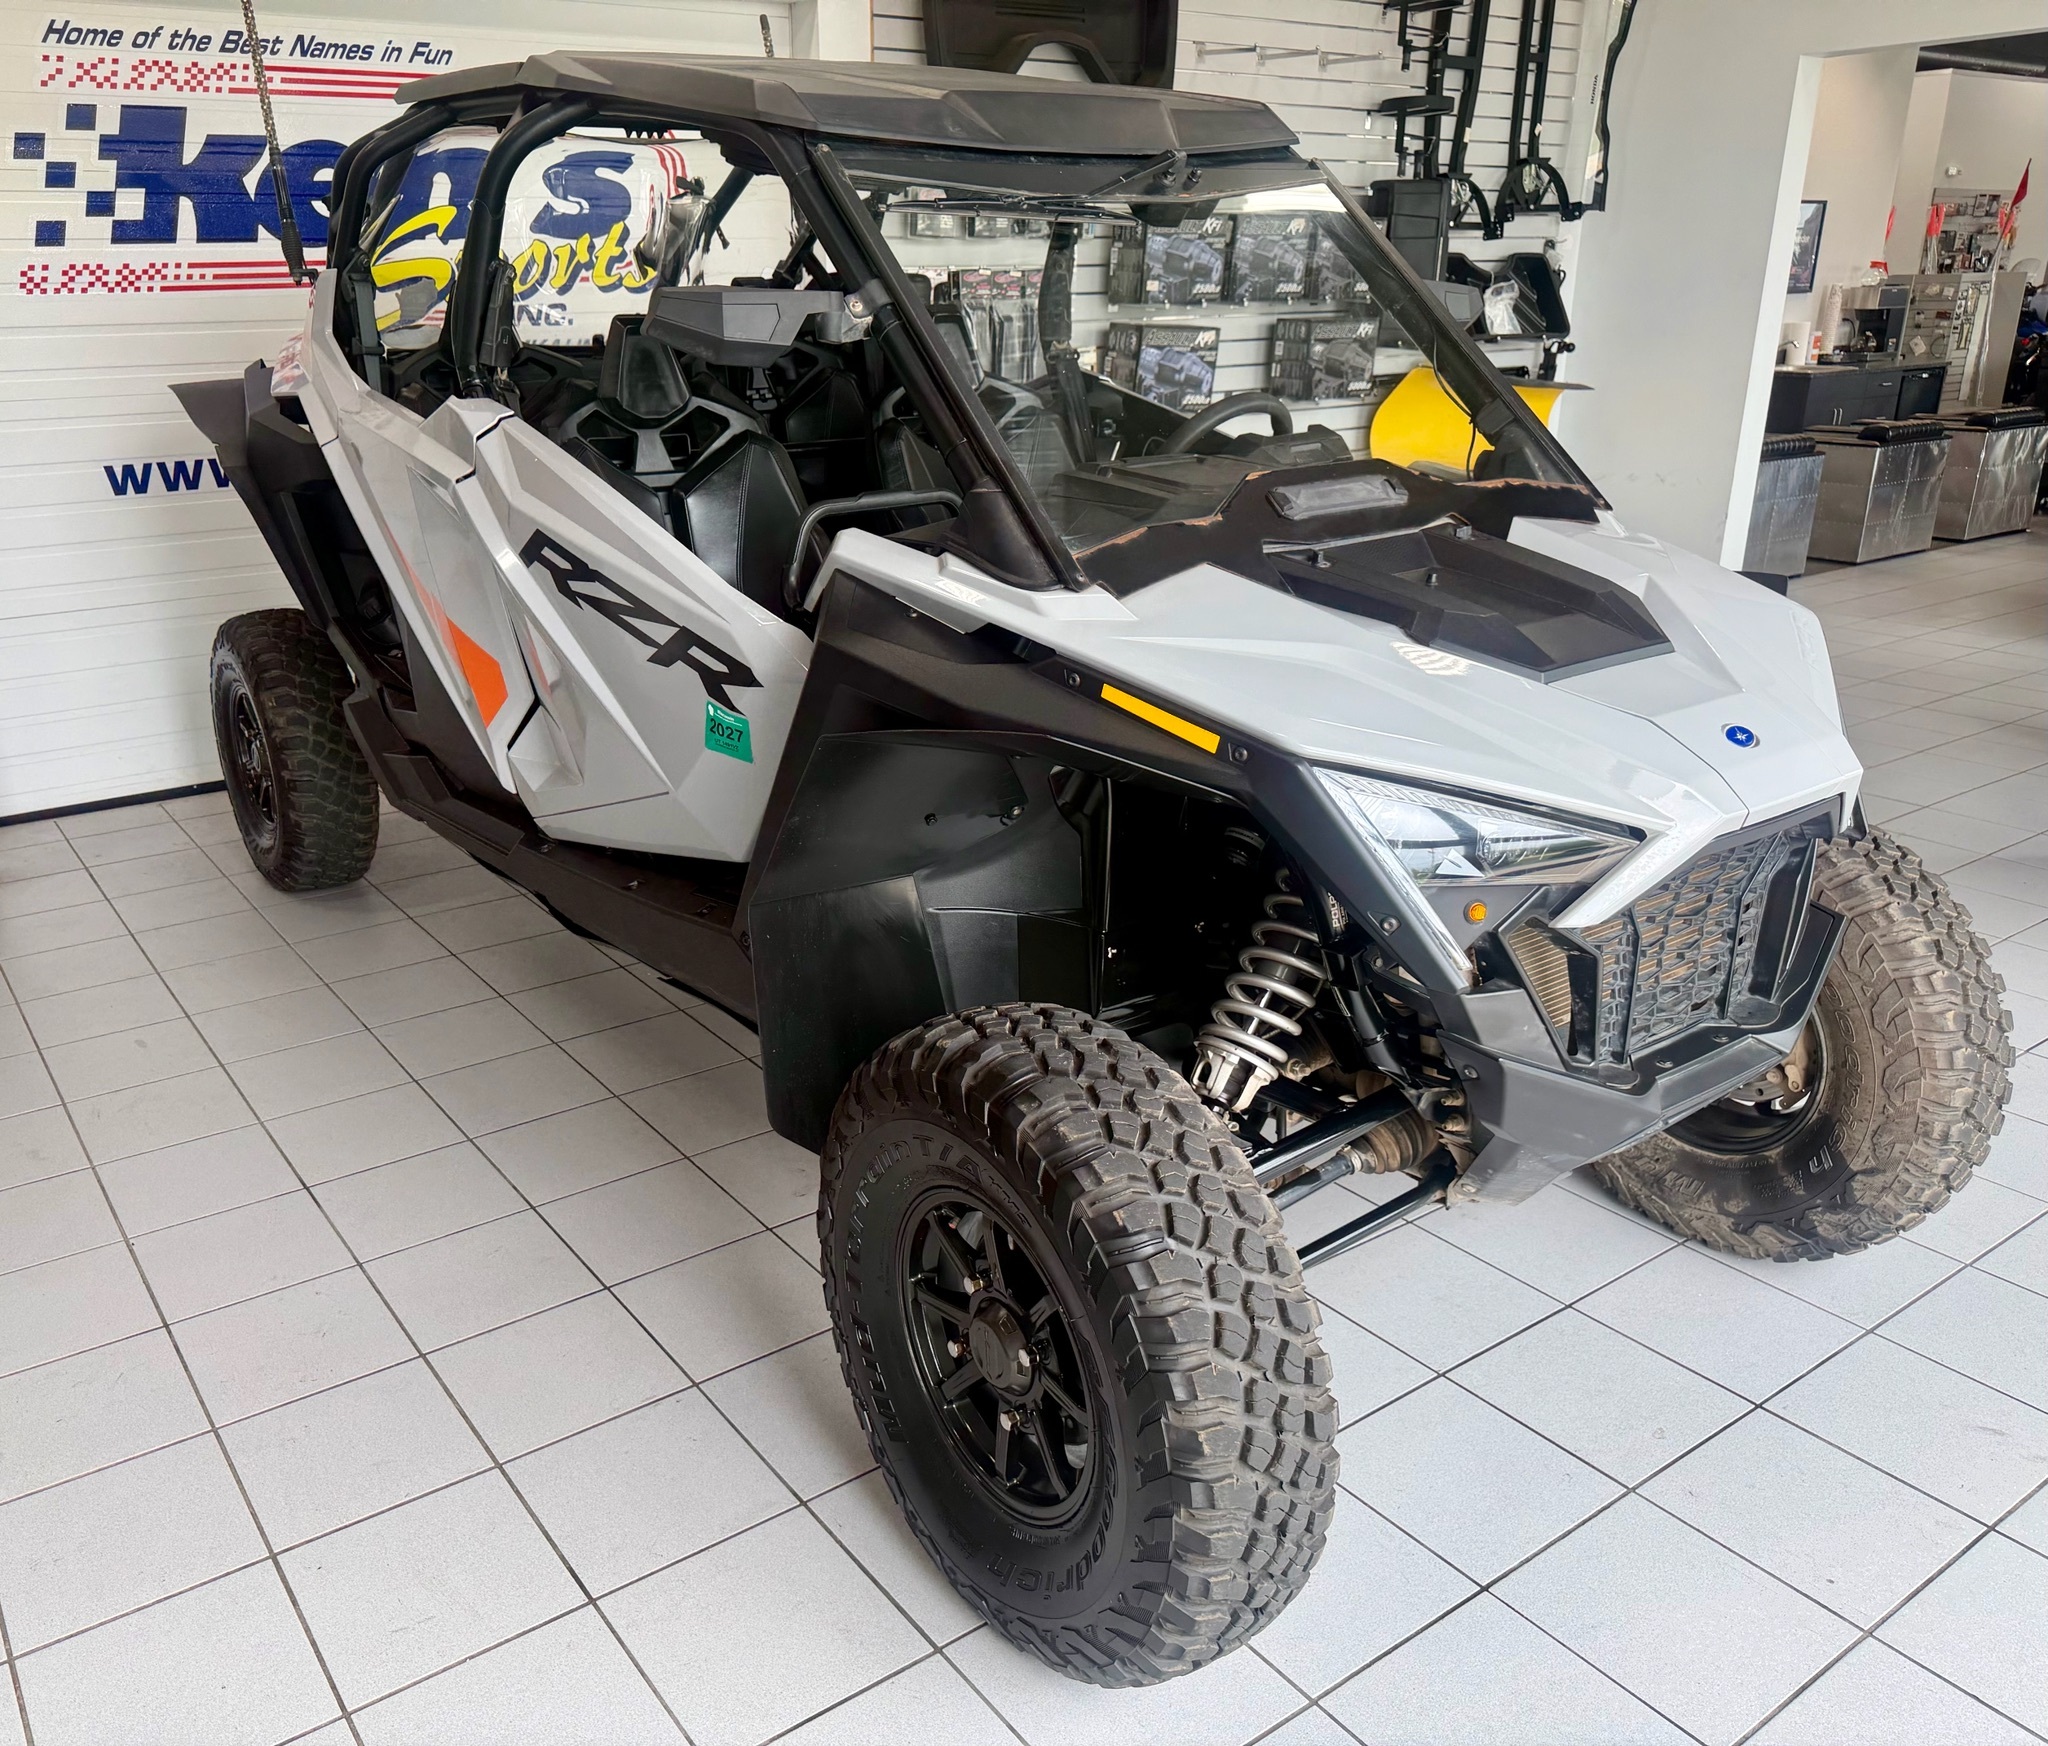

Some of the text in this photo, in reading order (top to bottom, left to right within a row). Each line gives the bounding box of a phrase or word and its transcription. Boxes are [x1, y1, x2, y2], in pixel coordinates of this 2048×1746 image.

[41, 19, 453, 66] Home of the Best Names in Fun
[1590, 74, 1599, 104] HONDA
[369, 204, 660, 333] Sorts
[513, 303, 574, 326] NC.
[518, 528, 764, 716] RZR
[709, 717, 743, 743] 2027
[1808, 979, 1865, 1174] oodrich
